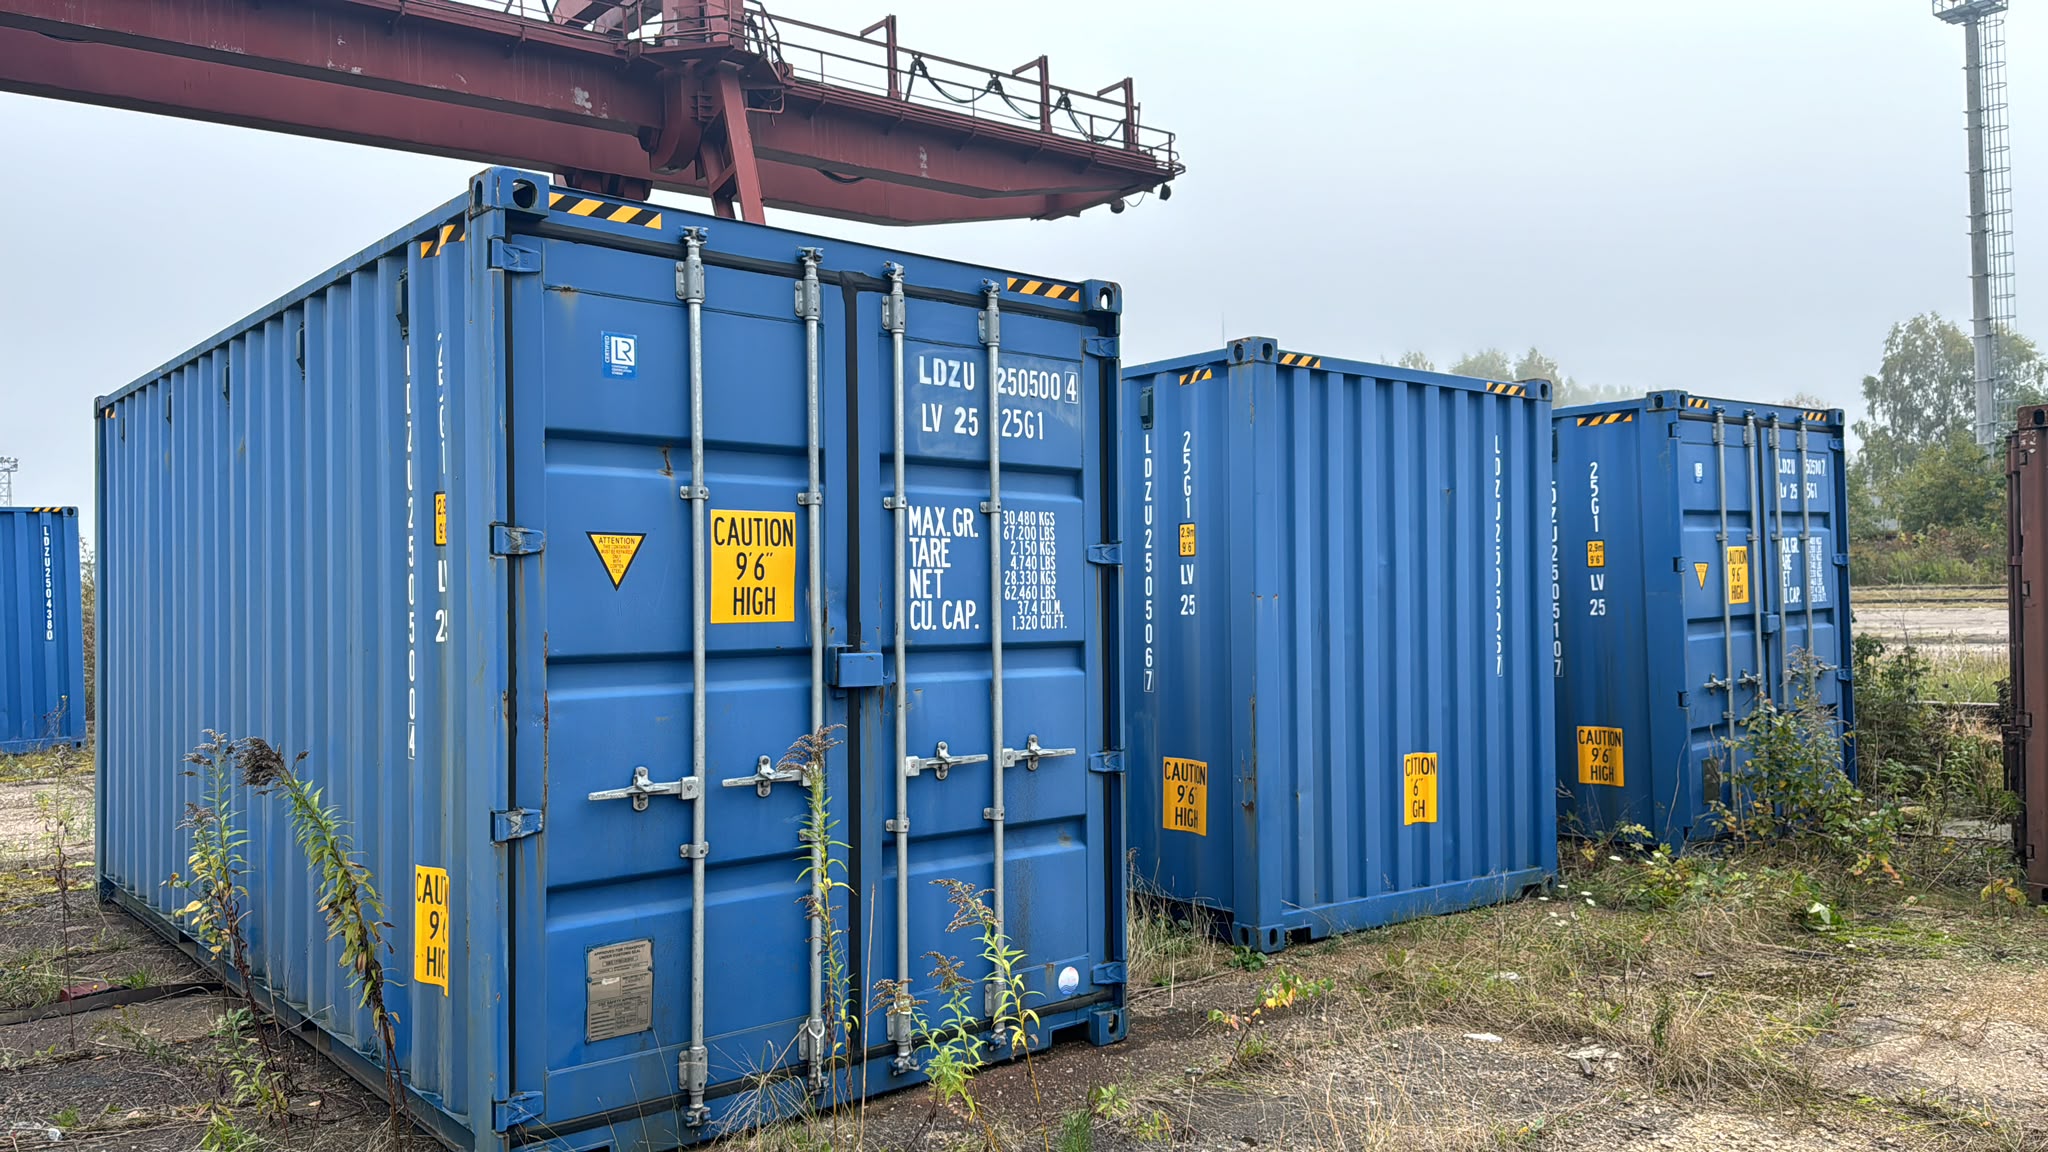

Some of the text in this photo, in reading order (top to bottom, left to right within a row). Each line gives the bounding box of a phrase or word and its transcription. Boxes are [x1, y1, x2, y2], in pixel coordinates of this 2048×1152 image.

[919, 356, 975, 390] LDZU
[921, 403, 1044, 440] LV 25 25G1
[1183, 431, 1191, 518] 25G1
[1590, 461, 1599, 532] 25G1
[1806, 483, 1817, 499] 5G1
[1039, 511, 1055, 526] KGS
[599, 536, 636, 545] ATTENTION
[713, 516, 794, 547] CAUTION
[1039, 527, 1056, 541] LBS
[909, 537, 951, 568] TARE
[1039, 541, 1056, 556] KGS
[1040, 556, 1056, 570] LBS
[1145, 434, 1153, 690] LDZU2505067
[43, 527, 54, 640] LDZU2504380
[910, 569, 944, 599] NET
[1040, 571, 1056, 585] KGS
[1181, 564, 1194, 585] LV
[1590, 574, 1604, 591] LV
[733, 587, 776, 616] HIGH
[1040, 585, 1056, 600] LBS
[910, 600, 979, 631] CU. CAP.
[1017, 600, 1063, 615] 37.4 CU.M.
[1181, 594, 1195, 616] 25
[1590, 598, 1606, 616] 25
[1040, 614, 1067, 630] CU.FT.
[1578, 729, 1622, 747] CAUTION
[1164, 761, 1206, 786] CAUTION
[1590, 765, 1615, 783] HIGH
[1174, 806, 1199, 829] HIGH
